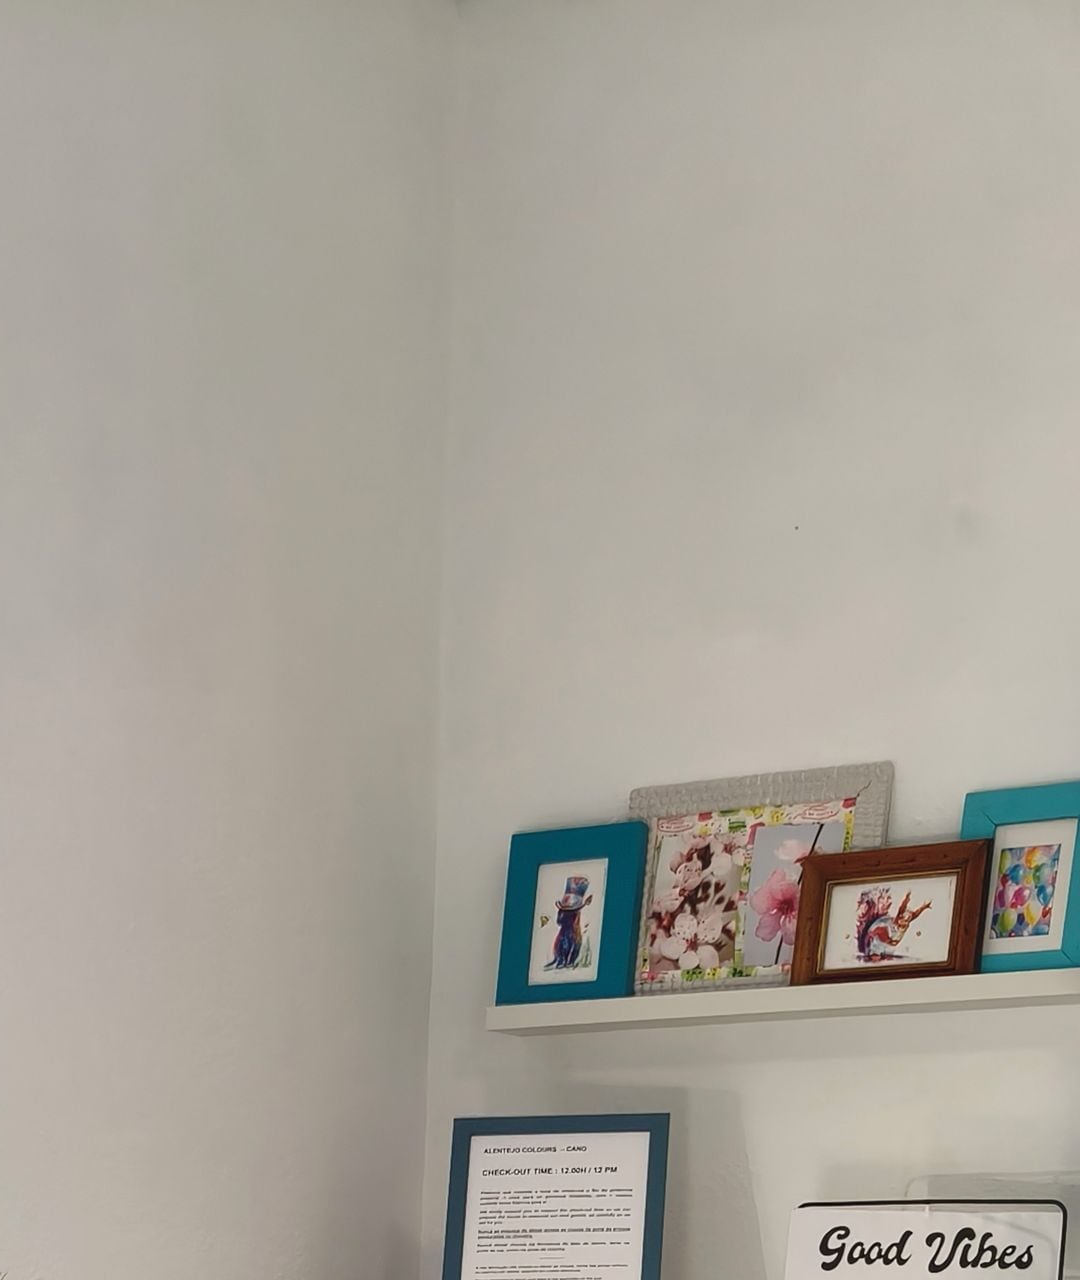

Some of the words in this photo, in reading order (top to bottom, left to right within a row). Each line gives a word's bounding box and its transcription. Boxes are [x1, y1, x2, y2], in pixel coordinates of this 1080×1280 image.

[482, 1168, 531, 1177] CHECK-OUT
[534, 1167, 553, 1175] TIME
[561, 1166, 587, 1174] 12.00H
[819, 1225, 913, 1271] Good
[925, 1227, 1034, 1273] Vibes
